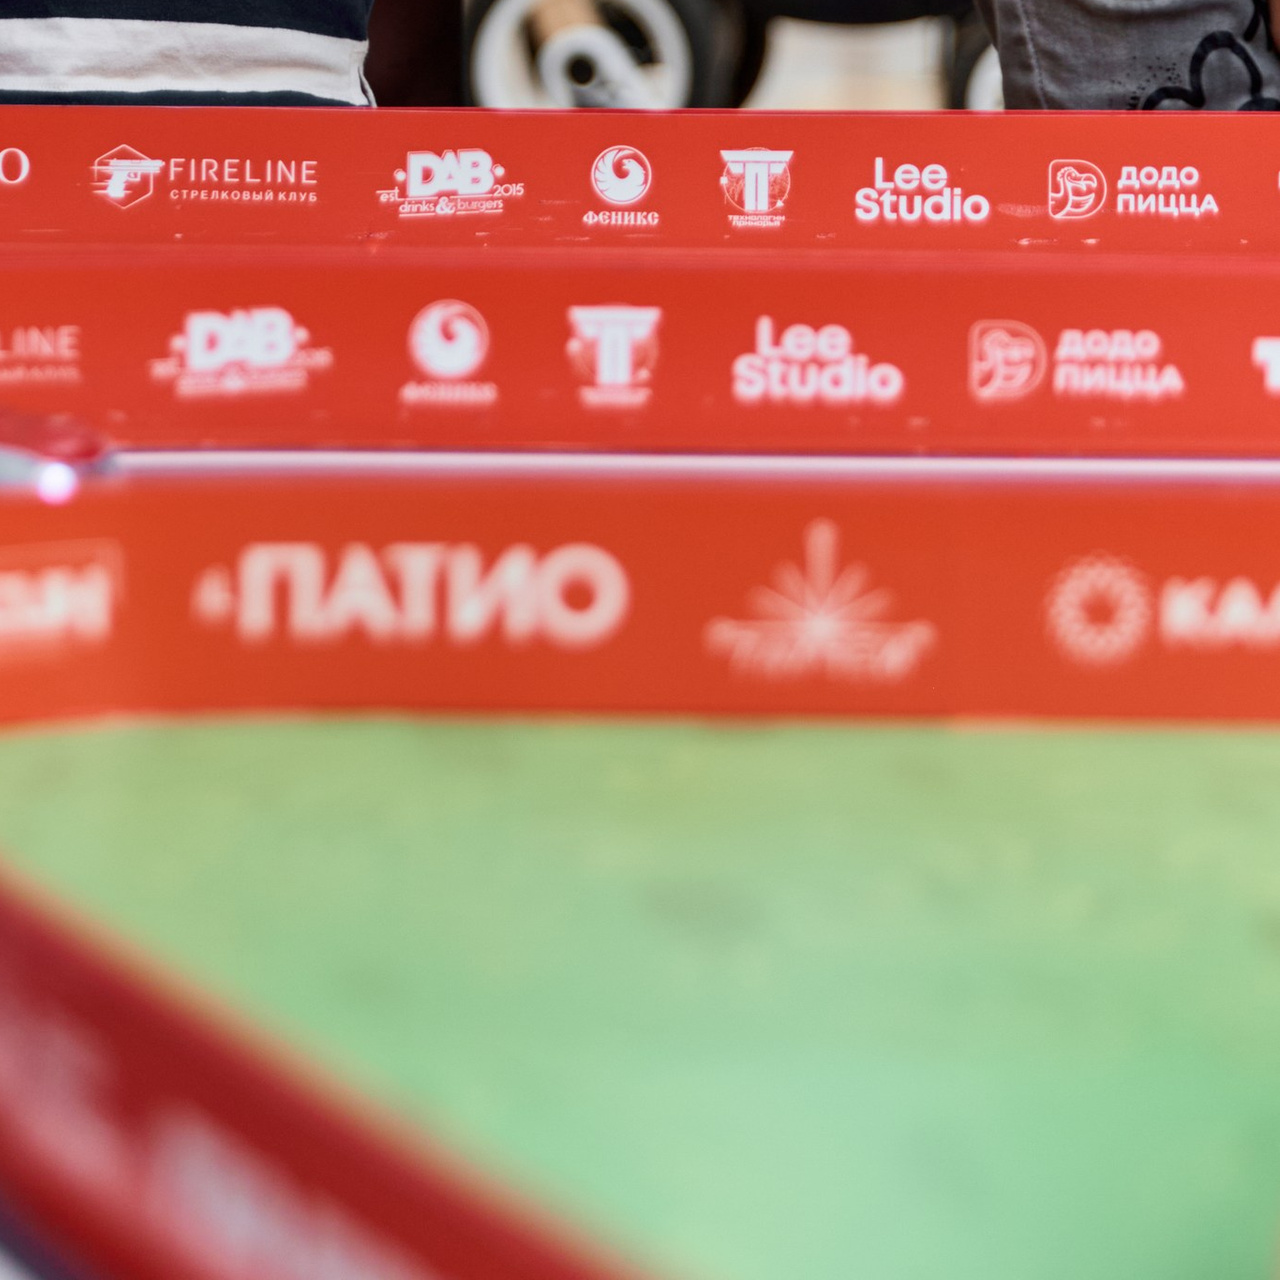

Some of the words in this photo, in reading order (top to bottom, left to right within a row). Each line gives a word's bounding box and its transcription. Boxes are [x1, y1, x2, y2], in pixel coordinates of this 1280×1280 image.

[170, 158, 318, 184] FIRELINE
[407, 148, 495, 197] DAB
[875, 156, 948, 190] Lee
[1118, 166, 1200, 189] ДОДО
[170, 189, 274, 201] СТРЕЛКОВЫЙ
[278, 191, 318, 202] КЛУБ
[493, 183, 525, 197] 2015
[399, 200, 435, 213] drinks
[457, 198, 504, 213] burgers
[855, 187, 991, 221] Studio
[1117, 193, 1219, 217] ПИЦЦА
[582, 210, 660, 227] ФЕНИКС
[755, 315, 852, 361] Lee
[732, 353, 905, 402] Studio
[236, 542, 631, 646] ПАТИО
